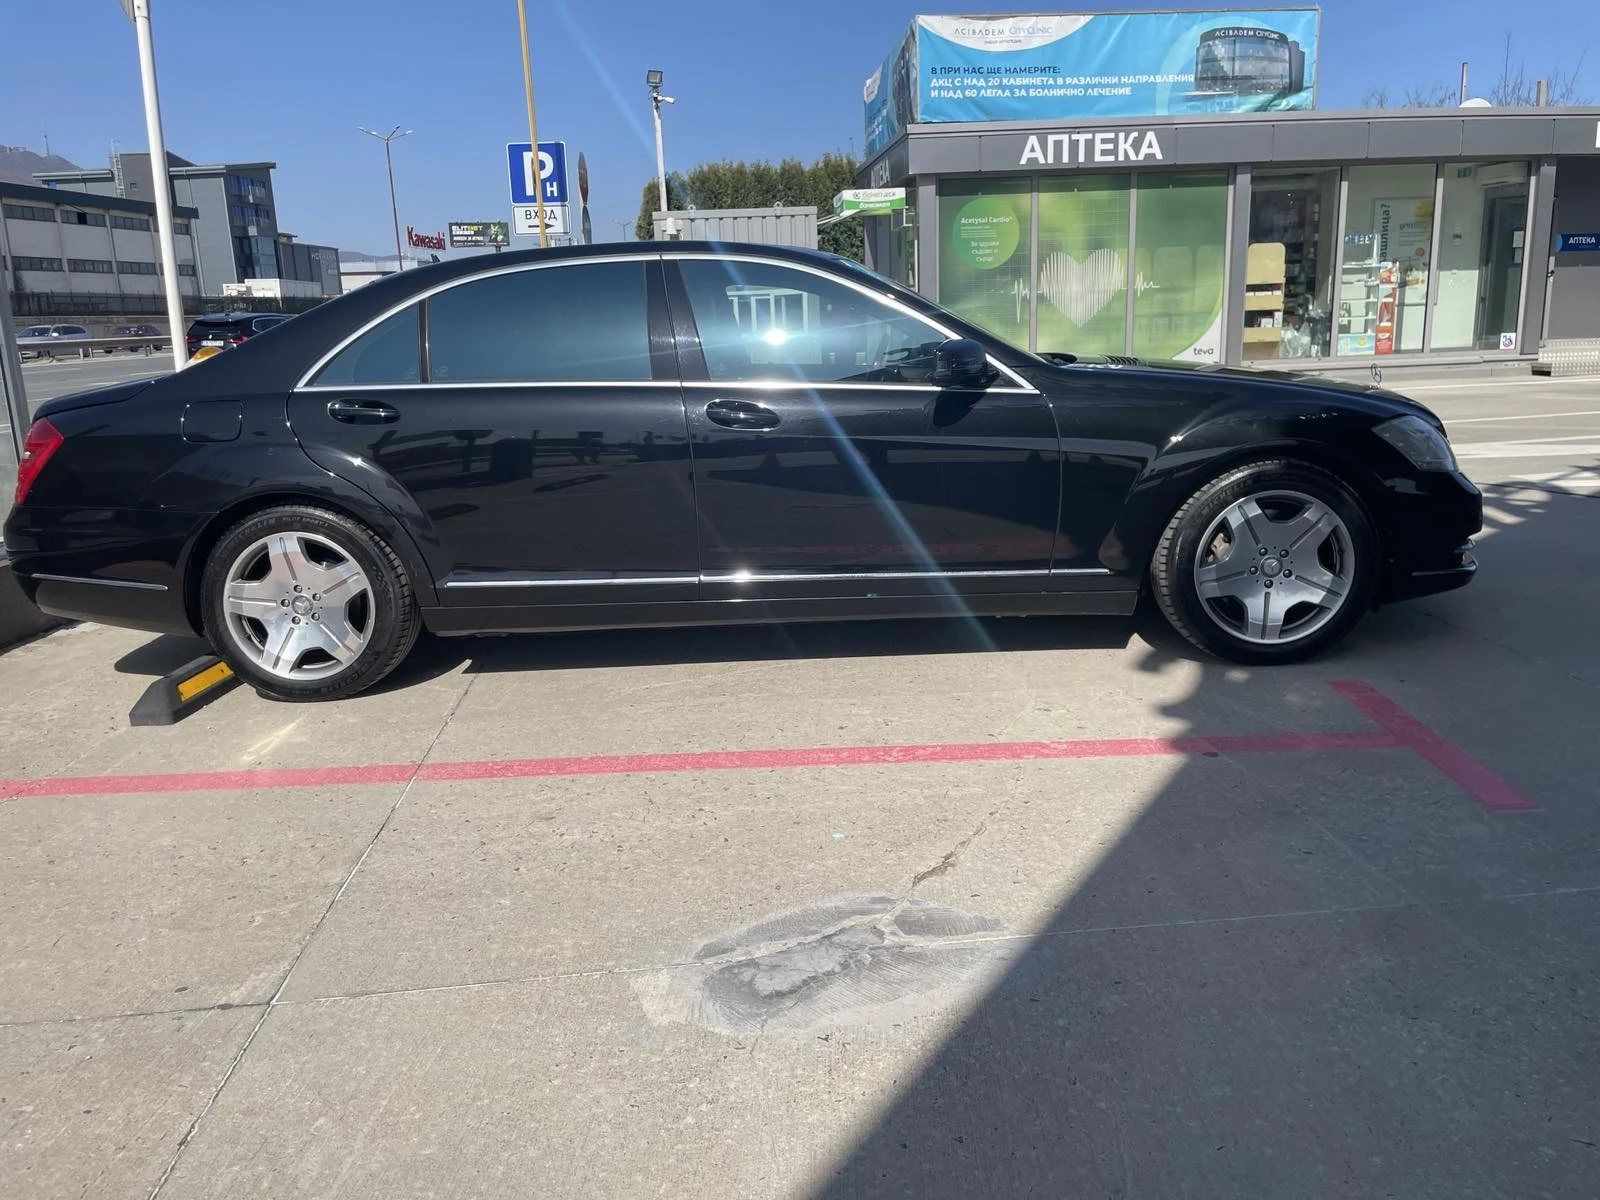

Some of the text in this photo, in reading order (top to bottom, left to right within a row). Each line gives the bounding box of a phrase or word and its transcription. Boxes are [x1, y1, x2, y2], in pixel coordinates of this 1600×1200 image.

[954, 27, 1005, 36] ACIBADEM
[1215, 29, 1254, 37] ACIBADEM
[940, 66, 961, 75] ПРИ
[963, 66, 985, 75] НАС
[986, 66, 1002, 75] ЩЕ
[1004, 66, 1061, 75] НАМЕРИТЕ:
[930, 77, 953, 87] ДКЦ
[963, 77, 987, 87] НАД
[988, 77, 1000, 86] 20
[1002, 77, 1055, 86] КАБИНЕТА
[1056, 77, 1064, 85] В
[1065, 76, 1121, 85] РАЗЛИЧНИ
[1121, 74, 1195, 84] НАПРАВЛЕНИЯ
[930, 87, 1132, 99] И НАД 60 ЛЕГЛА ЗА БОЛНИЧНО ЛЕЧЕНИЕ
[1019, 131, 1163, 165] АПТЕКА
[406, 225, 446, 250] Kawasaki
[1568, 236, 1596, 244] АПТЕКА
[1193, 348, 1214, 356] teva
